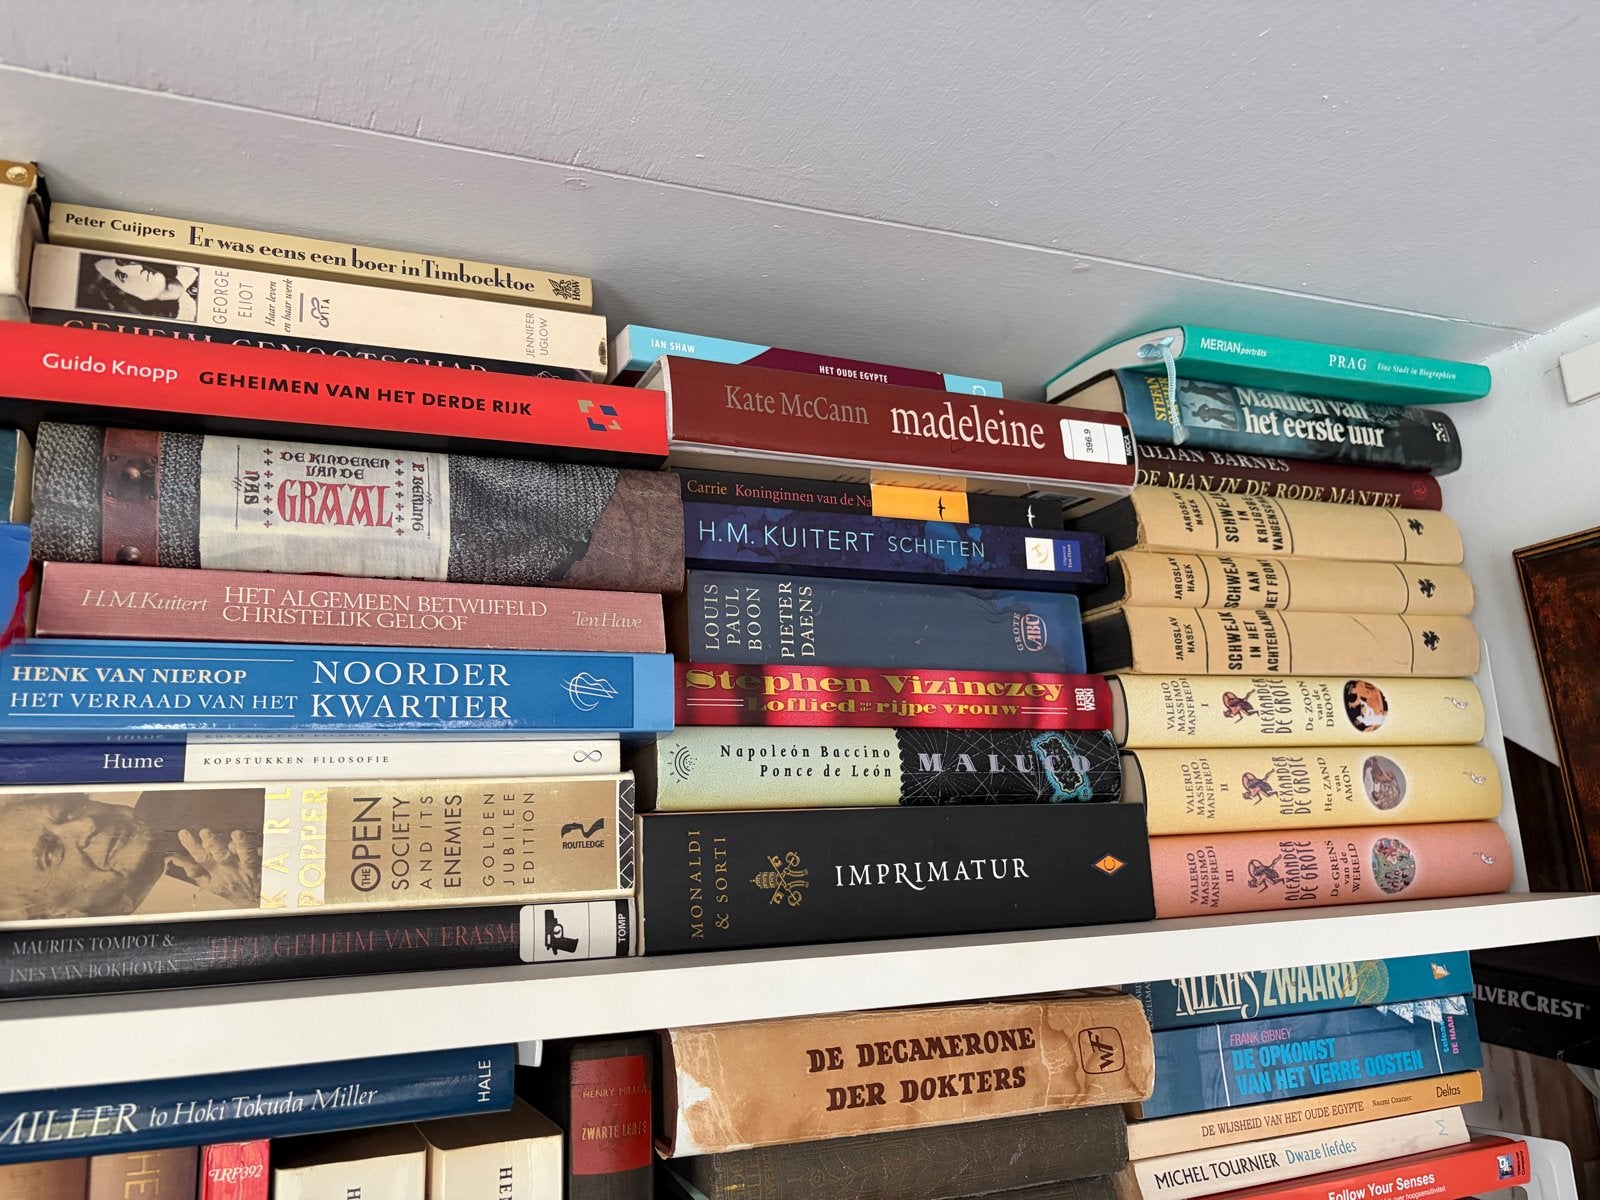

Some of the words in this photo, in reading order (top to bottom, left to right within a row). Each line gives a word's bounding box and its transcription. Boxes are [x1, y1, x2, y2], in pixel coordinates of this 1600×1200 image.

[65, 213, 106, 229] Peter
[110, 219, 176, 238] Cuijpers
[188, 225, 214, 248] Er
[217, 240, 255, 253] was
[259, 245, 306, 261] eens
[310, 252, 346, 267] een
[352, 248, 397, 273] boer
[401, 260, 420, 277] in
[421, 258, 535, 292] Timboektoe
[212, 270, 229, 325] GEORGE
[238, 283, 253, 318] ELIOT
[268, 280, 277, 306] leven
[265, 307, 275, 327] Haar
[285, 299, 293, 320] haar
[525, 312, 535, 358] JENNIFER
[540, 317, 549, 356] UGLOW
[651, 338, 667, 349] IAN
[670, 342, 695, 353] SHAW
[1200, 338, 1241, 351] MERIAN
[42, 353, 106, 373] Guido
[112, 360, 178, 384] Knopp
[819, 365, 834, 375] HET
[836, 368, 858, 379] OUDE
[860, 372, 888, 383] EGYPTE
[1329, 354, 1367, 371] PRAG
[1377, 363, 1391, 373] Eine
[1392, 364, 1410, 375] Stadt
[1419, 369, 1457, 380] Biographien
[199, 372, 319, 394] GEHEIMEN
[326, 383, 370, 400] VAN
[378, 389, 415, 404] HET
[423, 393, 486, 411] DERDE
[493, 401, 532, 416] RIJK
[724, 385, 775, 413] Kate
[780, 392, 870, 425] McCann
[1234, 386, 1330, 415] Mannen
[1327, 400, 1369, 420] van
[890, 402, 1046, 450] madeleine
[1086, 428, 1094, 453] 396.9
[1243, 407, 1281, 436] het
[1283, 416, 1347, 443] eerste
[1346, 425, 1385, 448] uur
[280, 451, 305, 462] DE
[309, 453, 389, 469] KINDEREN
[306, 465, 337, 478] VAN
[341, 468, 364, 479] DE
[1209, 452, 1290, 473] BARNES
[277, 479, 393, 527] GRAAL
[687, 480, 728, 496] Carrie
[735, 484, 814, 504] Koninginnen
[816, 493, 837, 505] van
[840, 495, 854, 506] de
[1167, 472, 1214, 491] MAN
[1217, 477, 1245, 493] IN
[1245, 480, 1273, 497] DE
[1275, 483, 1324, 501] RODE
[1329, 487, 1402, 508] MANTEL
[698, 520, 755, 545] H.M.
[764, 525, 874, 552] KUITERT
[888, 536, 985, 558] SCHIFTEN
[1218, 557, 1241, 608] SCHWEJK
[1246, 571, 1260, 592] AAN
[224, 586, 275, 605] HET
[280, 589, 411, 611] ALGEMEEN
[418, 596, 547, 617] BETWIJFELD
[1264, 590, 1279, 609] HET
[222, 605, 371, 627] CHRISTELIJK
[377, 613, 468, 631] GELOOF
[573, 610, 599, 627] Ten
[602, 613, 641, 629] Have
[704, 584, 720, 650] LOUIS
[727, 588, 741, 645] PAUL
[747, 587, 762, 651] BOON
[779, 581, 795, 658] PIETER
[799, 586, 815, 657] DAENS
[1243, 621, 1259, 640] HET
[1168, 617, 1184, 660] JAROSLAV
[1217, 611, 1243, 670] SCHWEJK
[1249, 646, 1261, 658] IN
[11, 666, 88, 683] HENK
[95, 667, 145, 683] VAN
[151, 669, 247, 685] NIEROP
[312, 660, 511, 686] NOORDER
[686, 669, 873, 695] Stephen
[880, 674, 1064, 702] Vizinczey
[10, 693, 63, 708] HET
[70, 693, 191, 709] VERRAAD
[198, 694, 245, 709] VAN
[251, 695, 298, 709] HET
[310, 693, 512, 718] KWARTIER
[750, 698, 856, 713] Loflied
[875, 700, 936, 717] rijpe
[943, 704, 1021, 716] vrouw
[1161, 682, 1175, 730] VALERIO
[1171, 680, 1186, 732] MASSIMO
[1179, 678, 1195, 735] MANFREDI
[102, 753, 164, 769] Hume
[203, 757, 304, 765] KOPSTUKKEN
[313, 756, 390, 764] FILOSOFIE
[720, 745, 811, 761] Napoleón
[820, 746, 891, 758] Baccino
[918, 754, 1090, 773] MALUCO
[1191, 761, 1206, 816] MASSIMO
[1200, 758, 1215, 819] MANFREDI
[260, 787, 292, 909] KARL
[297, 787, 328, 908] POPPER
[391, 796, 410, 890] SOCIETY
[444, 795, 462, 888] ENEMIES
[562, 840, 605, 849] ROUTLEDGE
[688, 829, 704, 940] MONALDI
[713, 836, 729, 903] SORTI
[835, 857, 1030, 891] IMPRIMATUR
[1205, 845, 1219, 908] MANFREDI
[384, 927, 430, 949] VAN
[617, 914, 627, 943] TOMP
[12, 937, 84, 956] MAURITS
[89, 934, 158, 951] TOMPOT
[10, 966, 46, 983] INES
[1261, 963, 1359, 1006] ZWAARD
[1230, 1031, 1259, 1045] FRANK
[1261, 1027, 1292, 1042] GIBNEY
[1447, 1016, 1458, 1040] HAAN
[806, 1047, 844, 1073] DE
[858, 1027, 1036, 1068] DECAMERONE
[1232, 1047, 1256, 1071] DE
[1259, 1038, 1336, 1067] OPKOMST
[477, 1059, 491, 1102] HALE
[826, 1084, 887, 1112] DER
[900, 1066, 1026, 1104] DOKTERS
[1236, 1071, 1272, 1096] VAN
[1275, 1067, 1306, 1090] HET
[1310, 1060, 1361, 1087] VERRE
[1366, 1050, 1423, 1076] OOSTEN
[150, 1108, 168, 1127] to
[172, 1100, 227, 1125] Hoki
[232, 1090, 304, 1119] Tokuda
[311, 1083, 378, 1110] Miller
[583, 1088, 615, 1098] HENRY
[1436, 1084, 1461, 1098] Deltas
[582, 1125, 619, 1140] ZWARTE
[1217, 1118, 1262, 1134] WIJSHEID
[1332, 1101, 1364, 1115] EGYPTE
[1285, 1147, 1321, 1165] Dwaze
[1322, 1140, 1357, 1158] liefdes
[208, 1164, 264, 1183] LRP392
[1154, 1166, 1209, 1190] MICHEL
[1208, 1153, 1280, 1179] TOURNIER
[1368, 1181, 1393, 1198] Your
[1396, 1173, 1435, 1191] Senses
